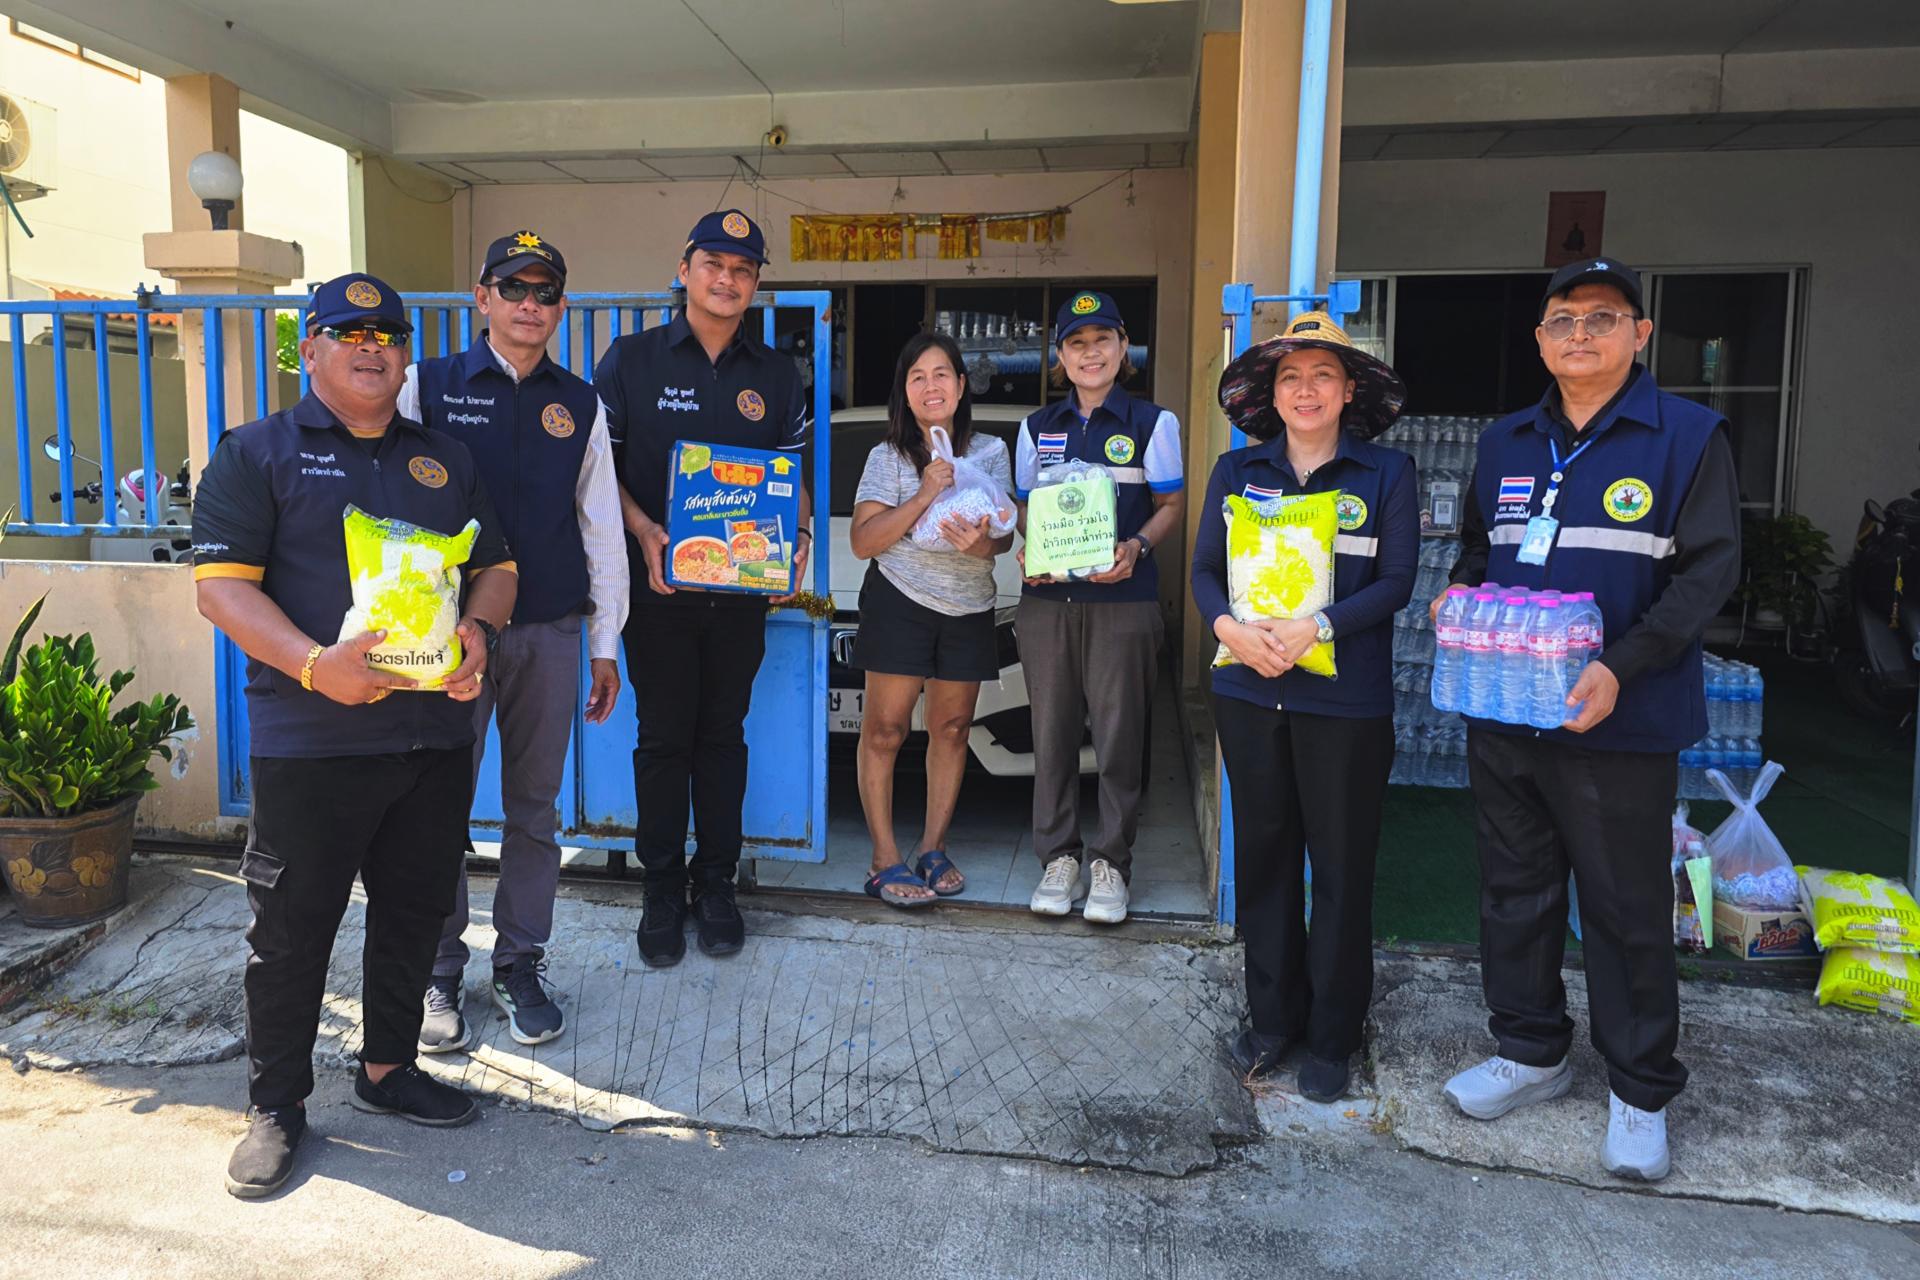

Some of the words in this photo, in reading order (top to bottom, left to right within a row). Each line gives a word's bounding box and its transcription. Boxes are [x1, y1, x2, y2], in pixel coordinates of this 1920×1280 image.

[1041, 517, 1074, 531] ร่วมมือ
[1078, 511, 1109, 526] ร่วมใจ
